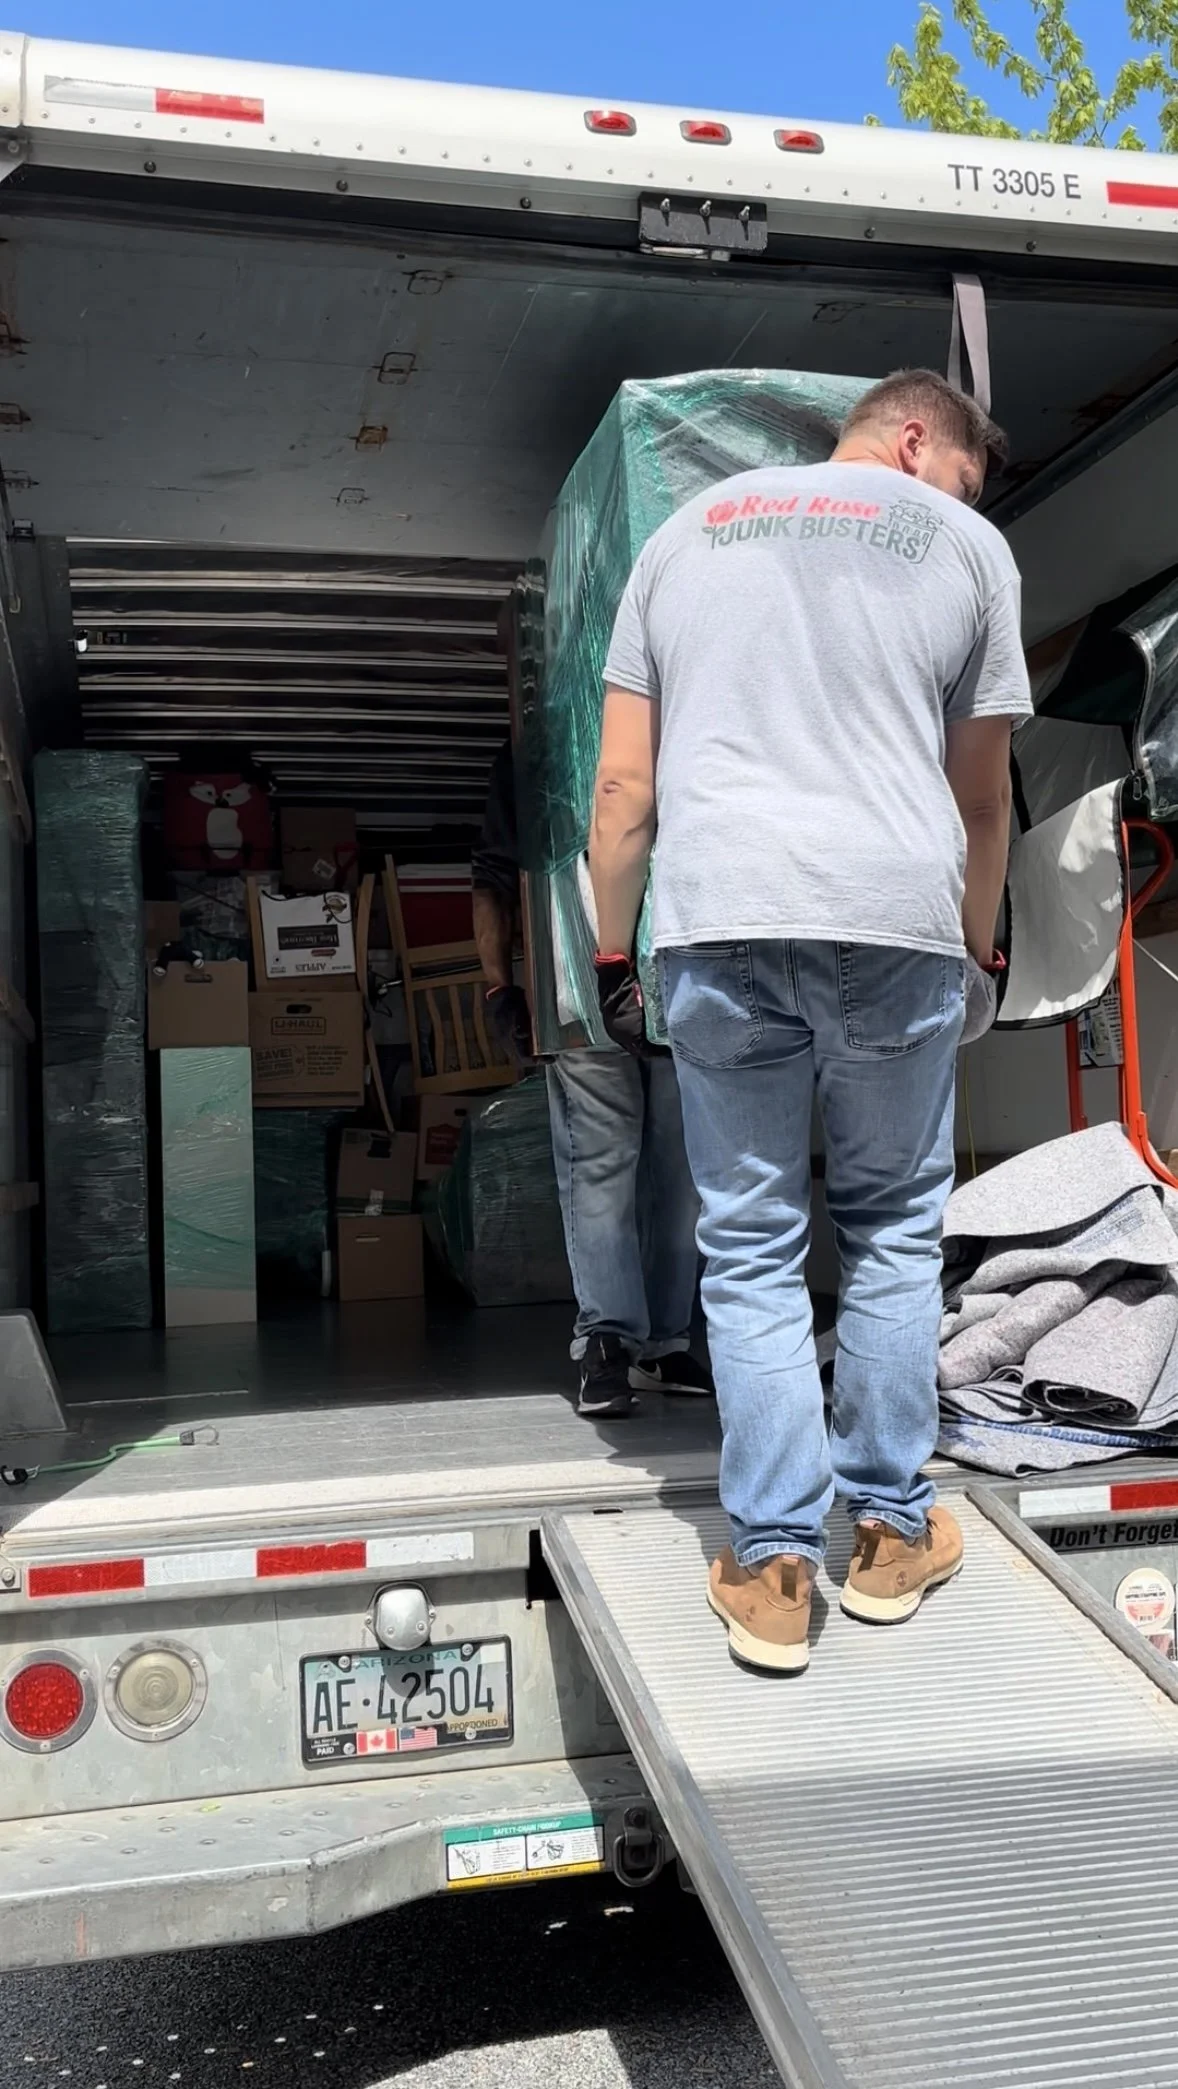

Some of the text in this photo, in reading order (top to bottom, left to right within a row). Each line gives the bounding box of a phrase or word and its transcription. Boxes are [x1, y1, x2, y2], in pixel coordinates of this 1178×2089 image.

[948, 164, 1081, 199] TT 3305 E
[740, 495, 881, 518] Red Rose
[719, 516, 921, 561] JUNK BUSTERS
[1050, 1524, 1108, 1547] Don't
[354, 1650, 457, 1670] ARIZONA
